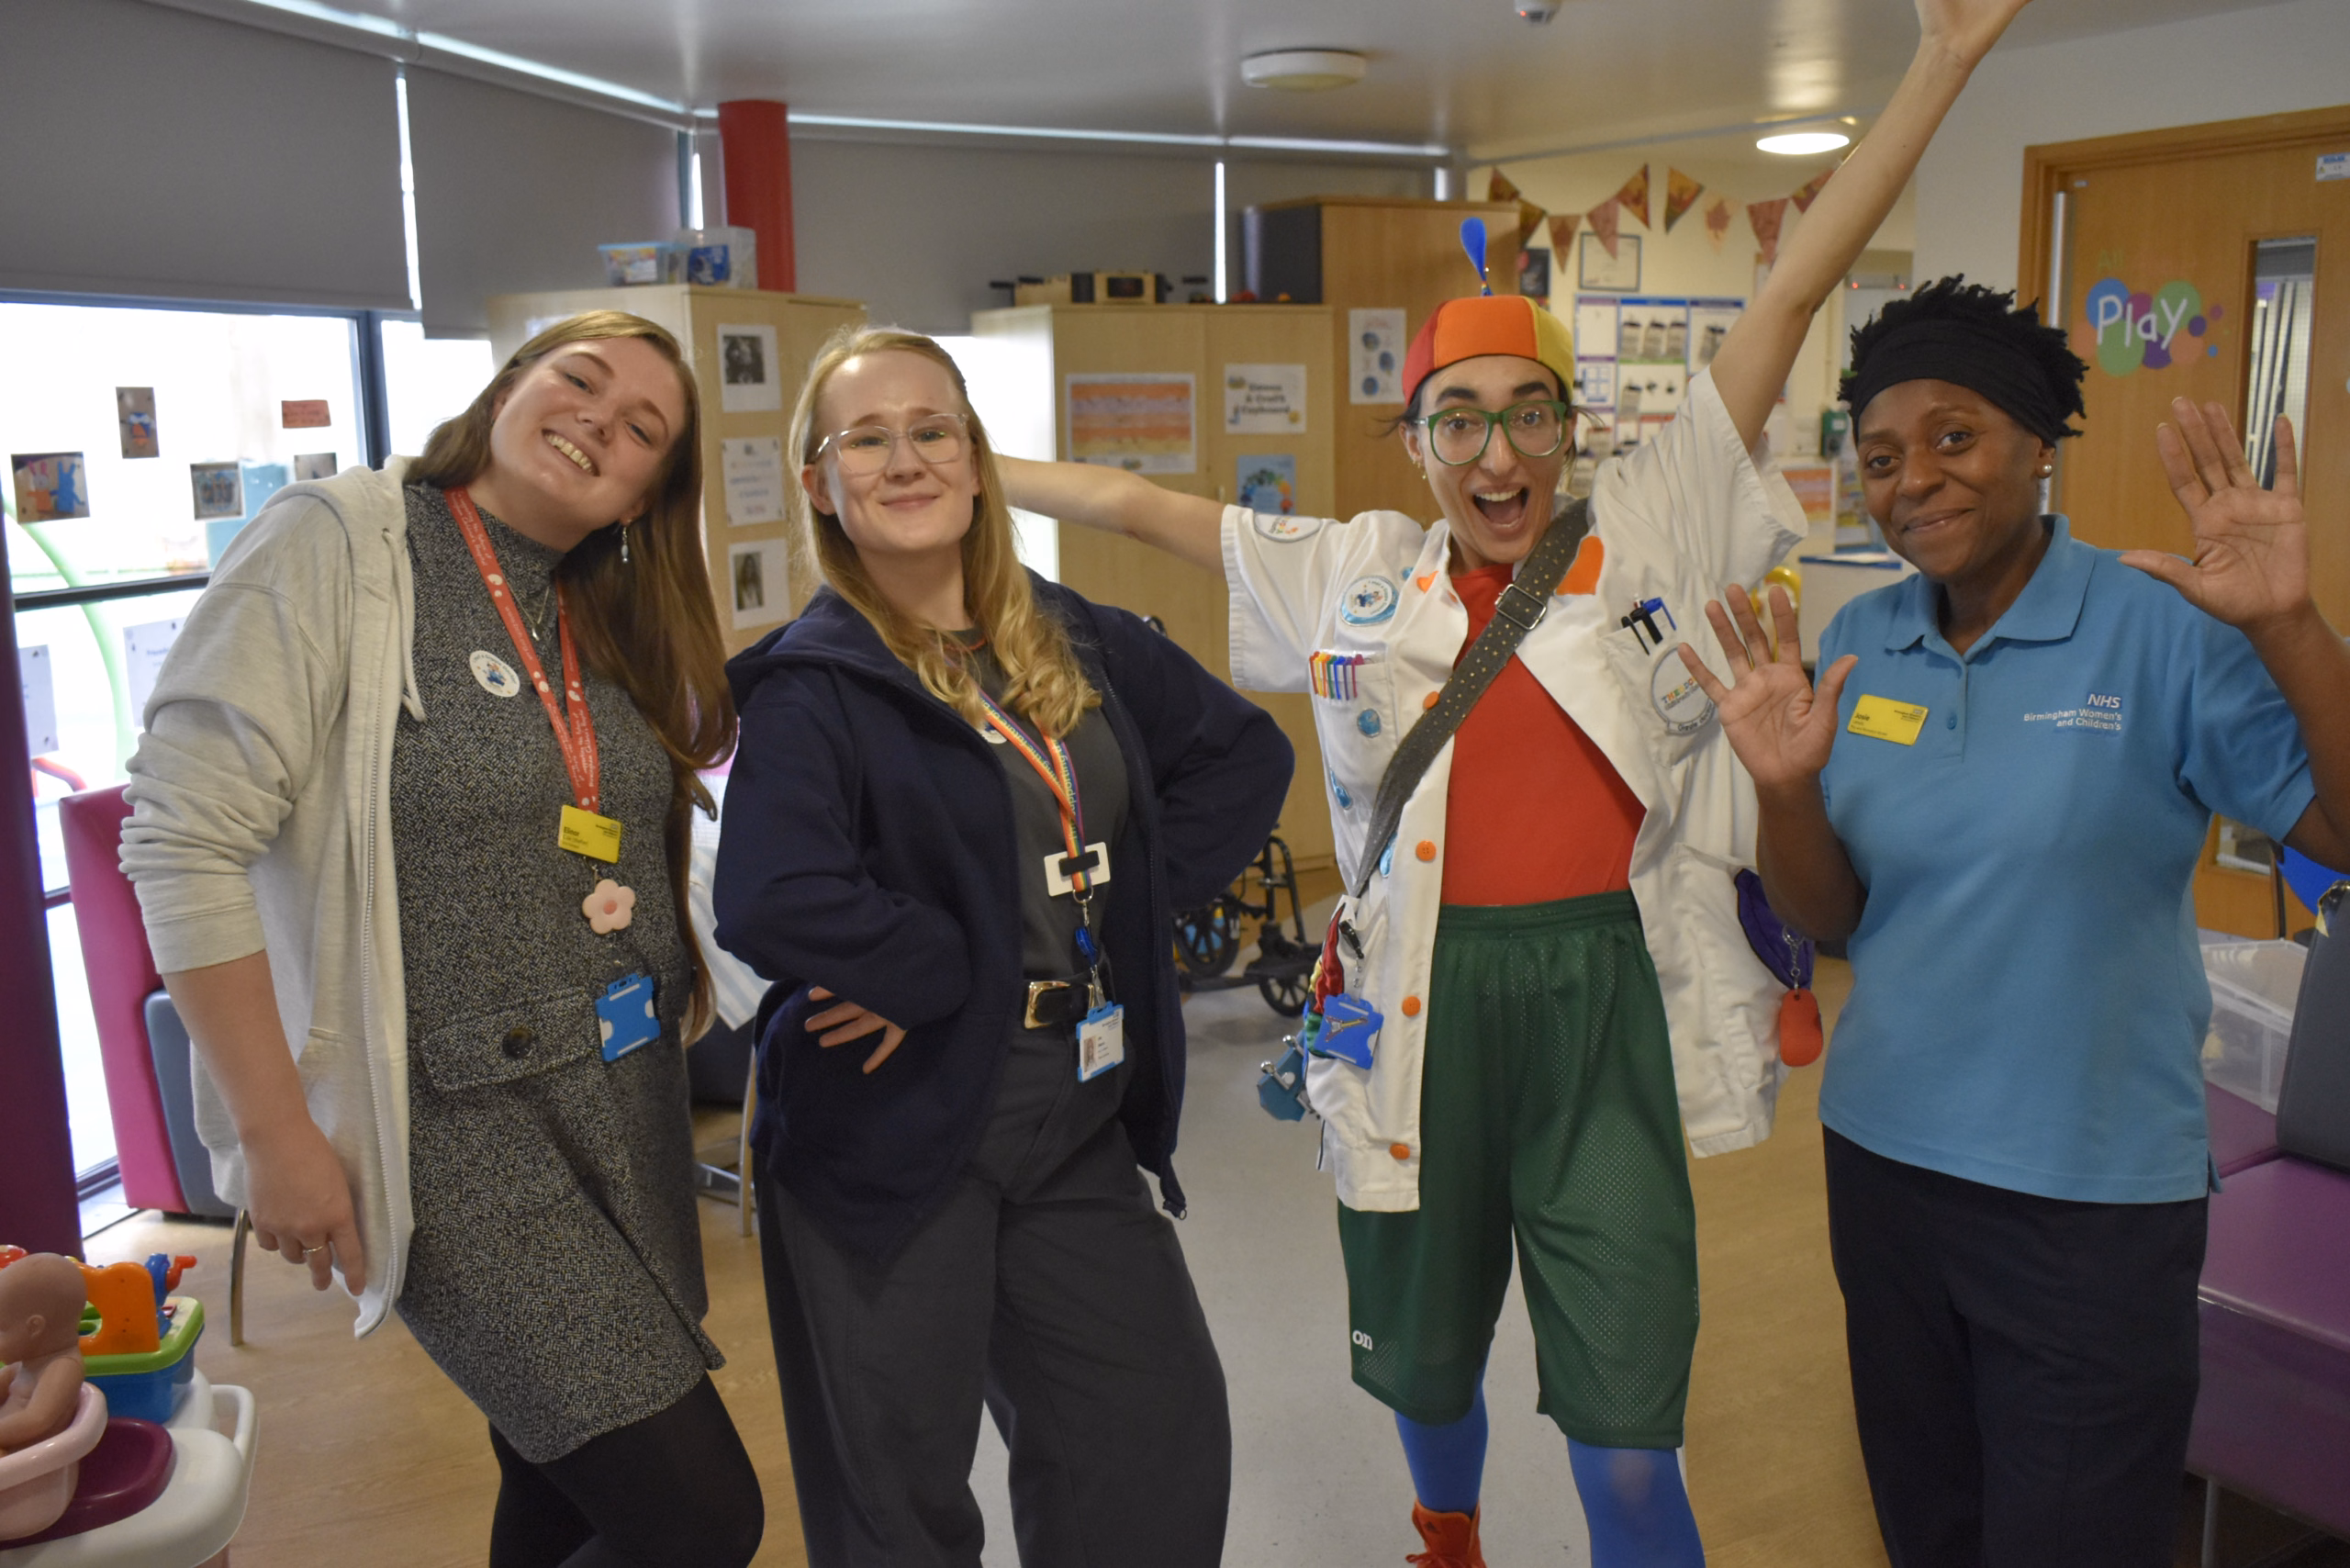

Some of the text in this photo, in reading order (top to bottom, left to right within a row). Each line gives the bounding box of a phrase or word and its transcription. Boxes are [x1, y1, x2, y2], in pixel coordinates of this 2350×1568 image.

[2097, 295, 2188, 350] Play
[2087, 693, 2121, 709] NHS
[2024, 709, 2122, 722] Birmingham Women's
[2057, 717, 2121, 731] and Children's
[986, 708, 1042, 763] the future of
[1352, 1329, 1373, 1351] on
